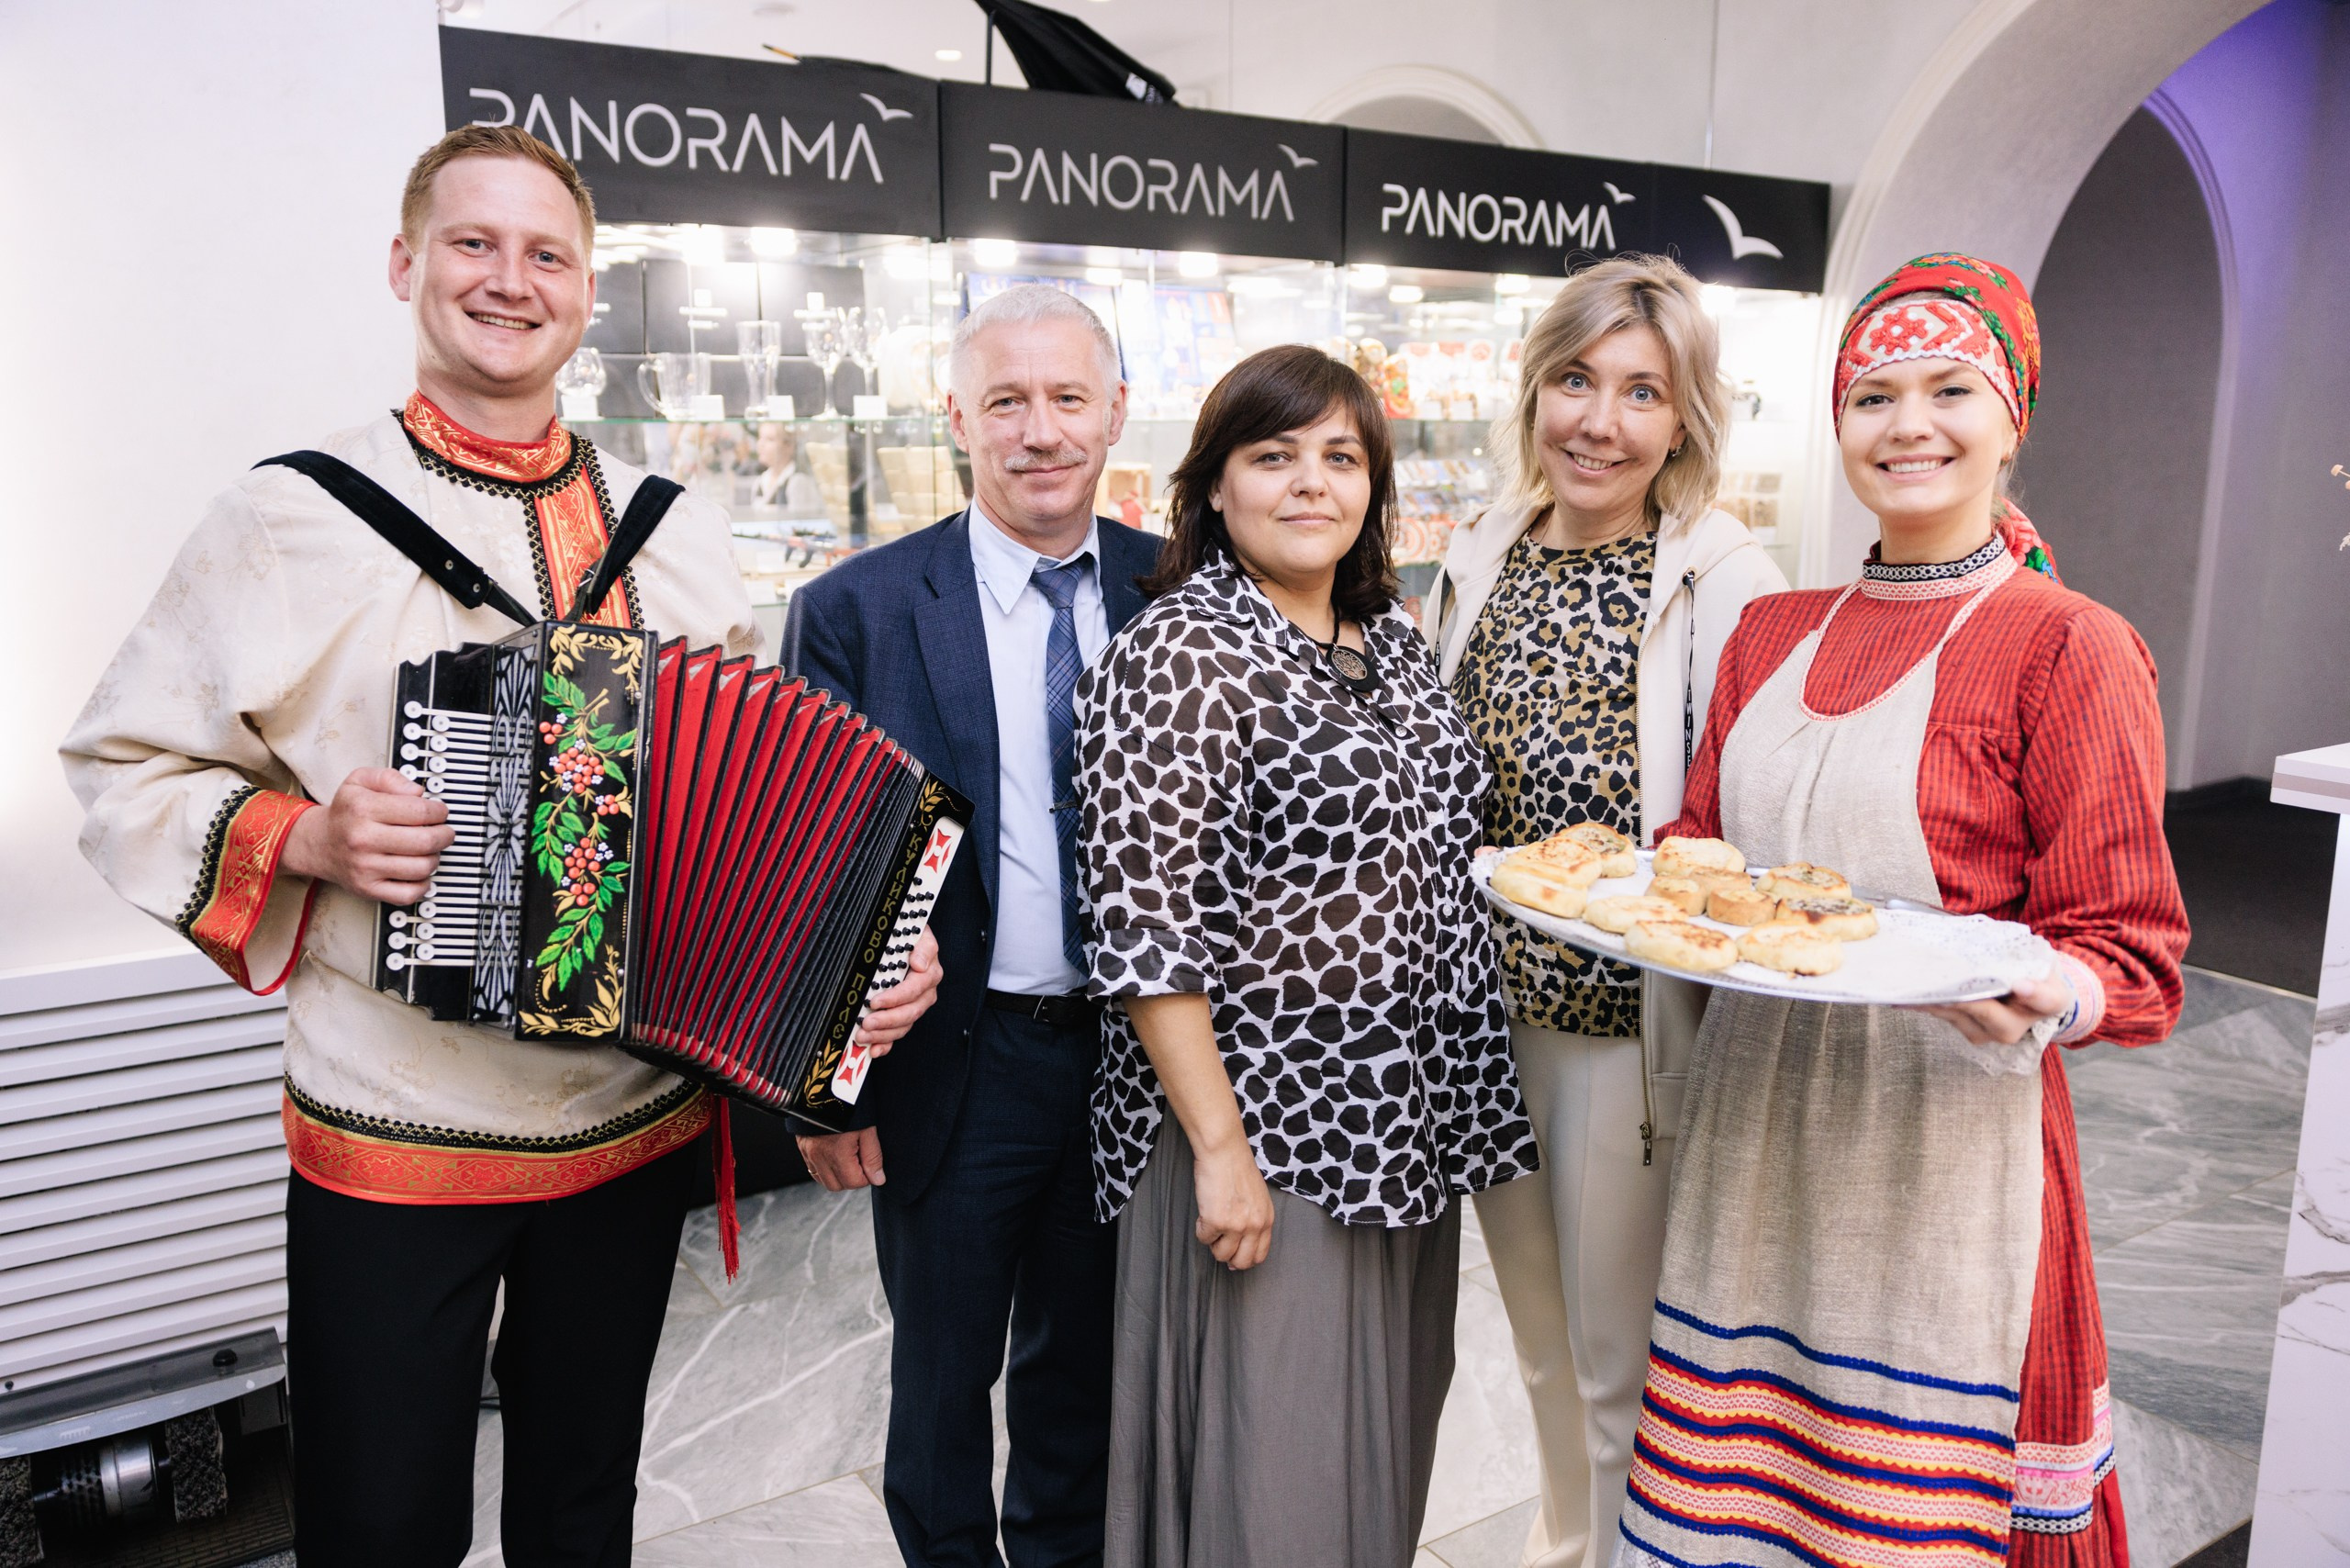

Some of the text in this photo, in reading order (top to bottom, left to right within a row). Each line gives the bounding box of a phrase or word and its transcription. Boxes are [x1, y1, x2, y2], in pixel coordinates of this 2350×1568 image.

[469, 87, 885, 184] PANORAMA
[988, 142, 1295, 222] PANORAMA
[1381, 183, 1617, 251] PANORAMA
[833, 833, 923, 1039] КУЛИКОВО ПОЛЕ
